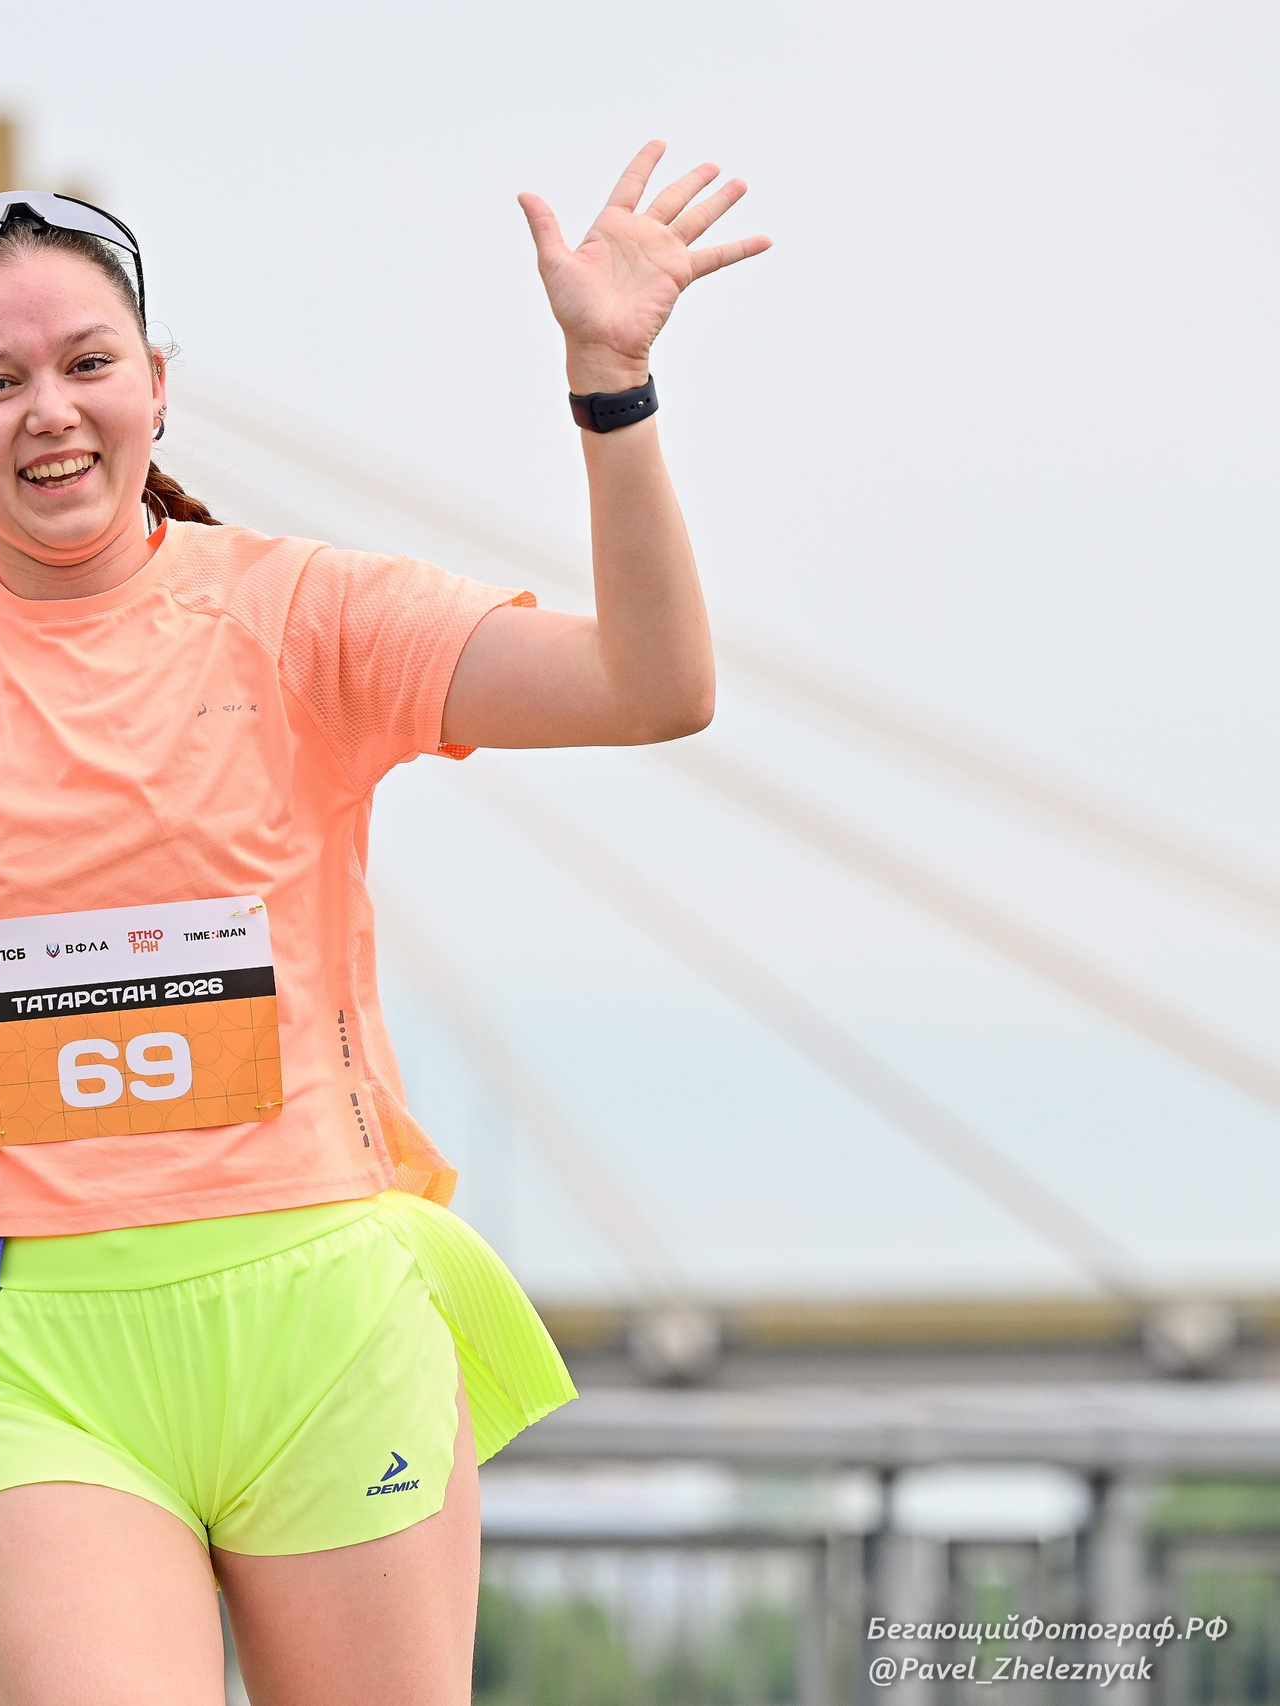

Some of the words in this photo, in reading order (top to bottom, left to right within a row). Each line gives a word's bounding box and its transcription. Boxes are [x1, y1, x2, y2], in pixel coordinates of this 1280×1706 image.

[65, 940, 109, 954] ВФЛА
[11, 984, 157, 1013] ТАТАРСТАН
[164, 978, 223, 999] 2026
[57, 1032, 192, 1108] 69
[366, 1479, 420, 1496] DEMIX
